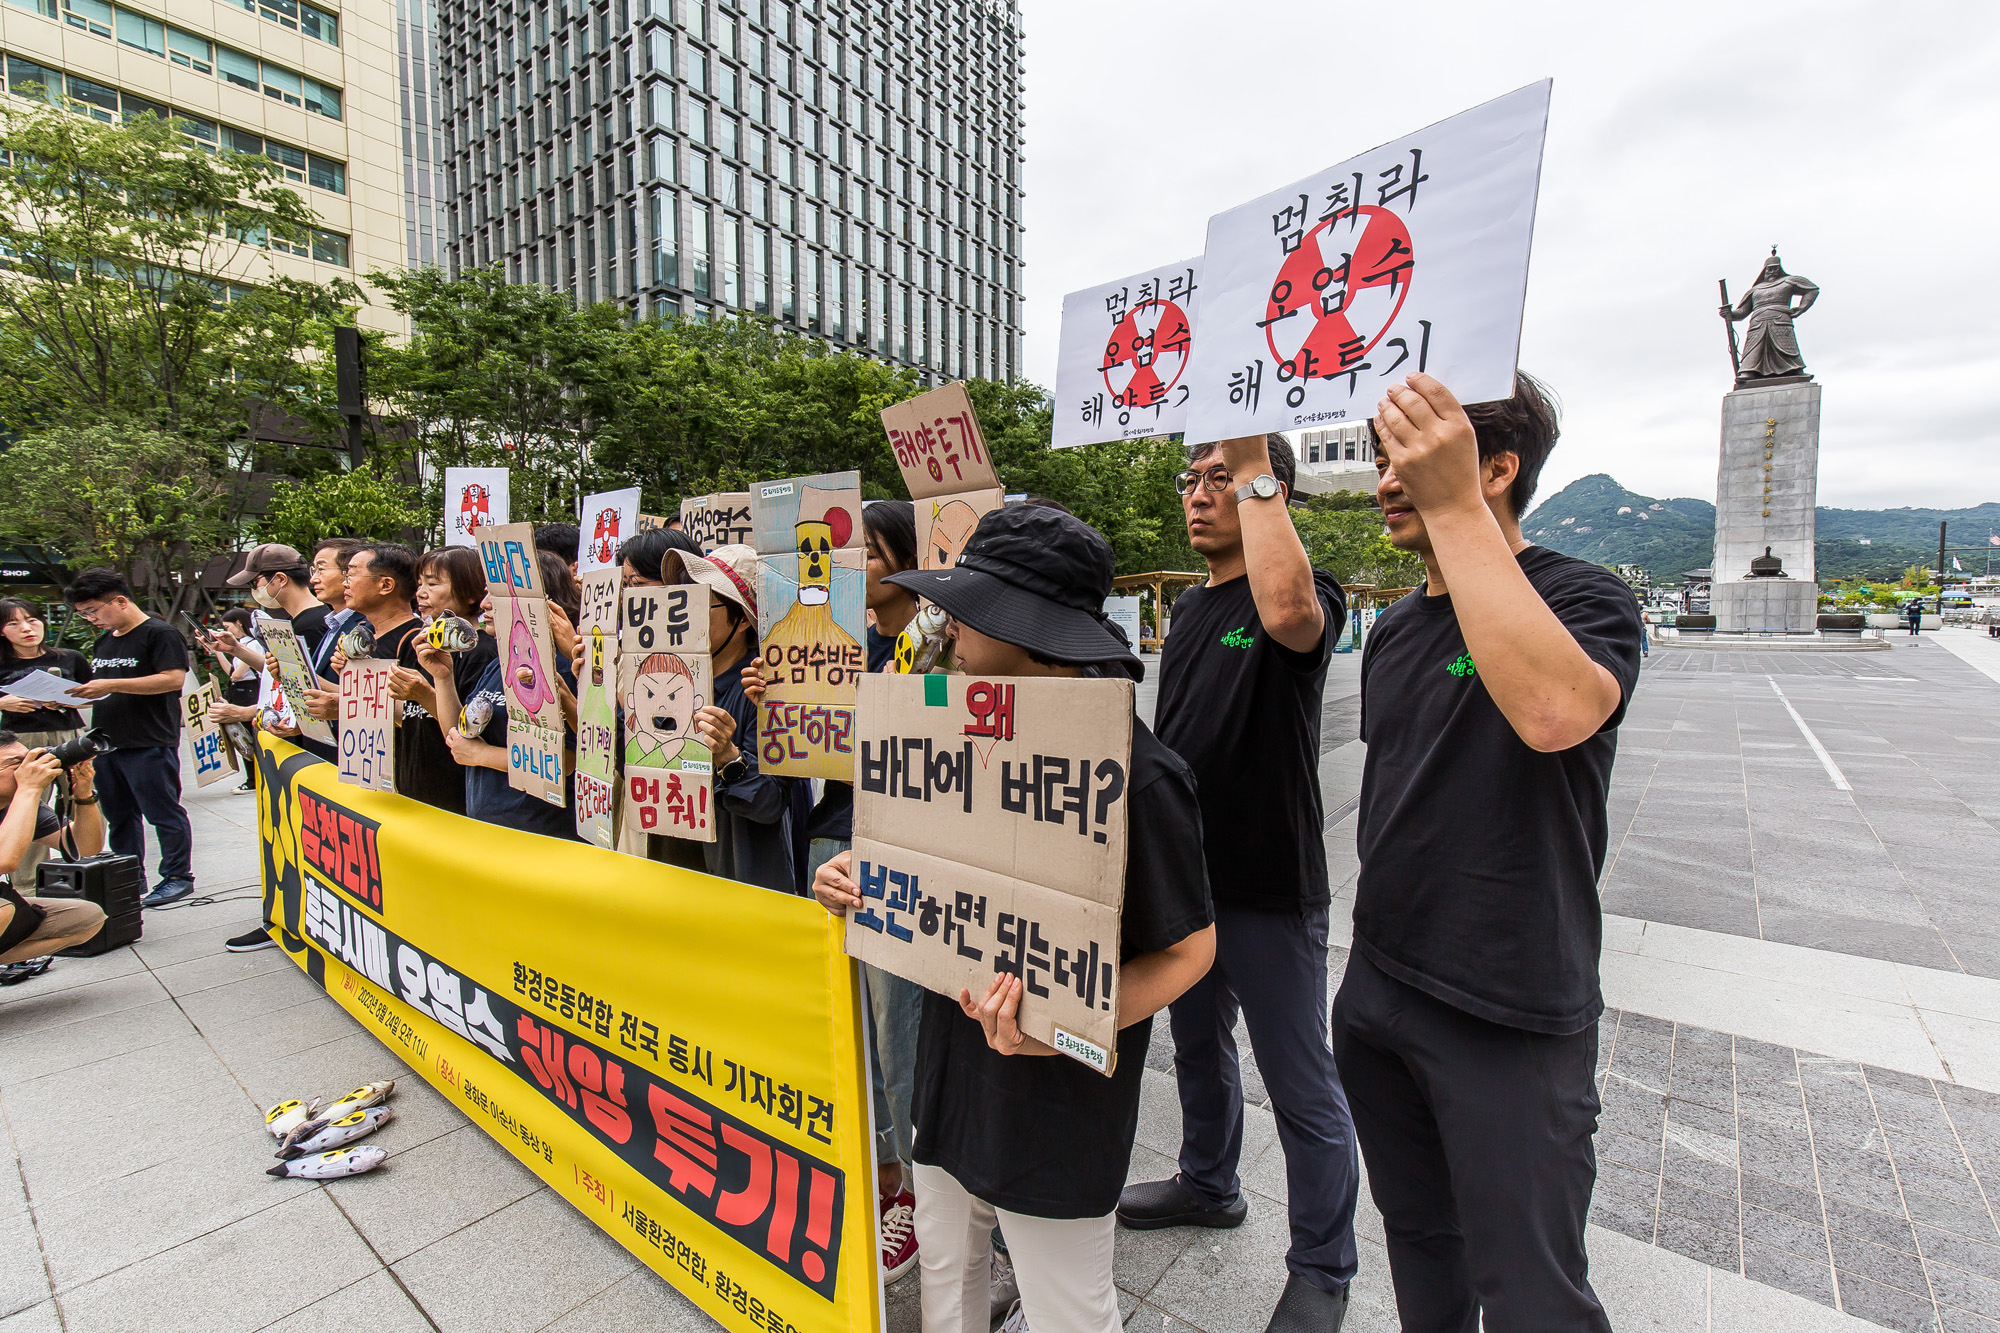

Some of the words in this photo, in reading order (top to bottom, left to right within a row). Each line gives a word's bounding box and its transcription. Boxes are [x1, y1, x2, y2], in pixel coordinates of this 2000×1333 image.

[1272, 148, 1429, 257] 멈춰라
[1105, 268, 1198, 326] 멈춰라
[1256, 237, 1415, 328] 오염수
[1096, 322, 1192, 373] 오염수
[1228, 319, 1432, 415] 해양투기
[1302, 408, 1347, 423] 서울환경연합
[889, 411, 983, 483] 해양투기
[480, 541, 531, 590] 바다
[528, 603, 539, 638] 는
[581, 578, 615, 622] 오염수
[627, 589, 690, 649] 방류
[1446, 655, 1476, 677] 서울환경
[963, 680, 1015, 741] 왜
[342, 727, 386, 784] 오염수
[511, 743, 562, 785] 아니다
[577, 772, 613, 823] 중단하라
[630, 772, 708, 830] 멈춰!
[861, 735, 973, 814] 바다에
[1001, 753, 1125, 845] 버려?
[299, 791, 381, 907] 멈춰라!
[854, 860, 987, 962] 보관하면
[993, 912, 1113, 1012] 되는데!
[304, 877, 397, 996] 후쿠시마
[397, 943, 516, 1063] 오염수
[517, 1013, 633, 1145] 해양
[648, 1082, 836, 1283] 투기!
[513, 960, 614, 1040] 환경운동연합
[619, 1010, 659, 1062] 전국
[667, 1033, 713, 1087] 동시
[723, 1058, 835, 1146] 기자회견
[357, 986, 379, 1015] 2023년
[375, 1002, 389, 1024] 8월
[384, 1011, 402, 1036] 24일
[397, 1023, 414, 1048] 오전
[412, 1035, 429, 1061] 11시
[464, 1078, 489, 1114] 광화문
[490, 1100, 519, 1138] 이순신
[519, 1123, 540, 1154] 동상
[541, 1140, 554, 1165] 앞
[622, 1200, 710, 1289] 서울환경연합,
[715, 1270, 803, 1333] 환경운동
